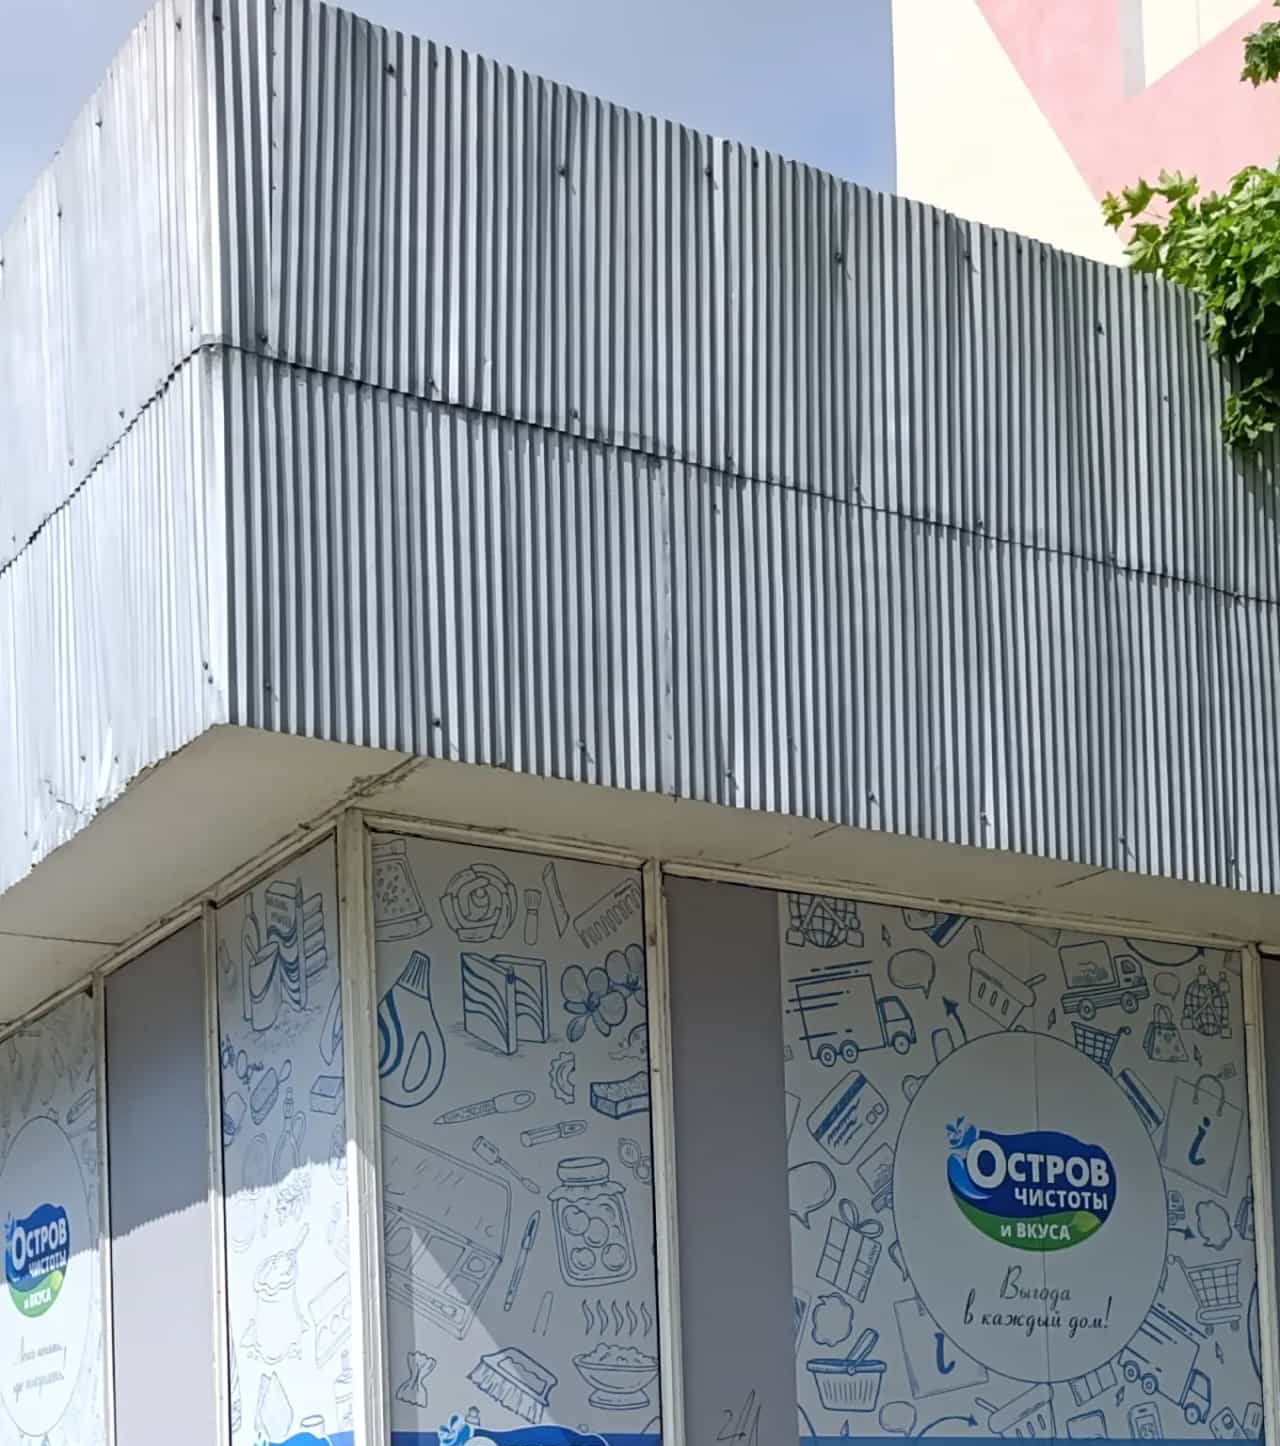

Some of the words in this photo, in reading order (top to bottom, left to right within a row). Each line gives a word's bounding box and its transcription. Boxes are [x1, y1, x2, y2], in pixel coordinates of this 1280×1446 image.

[966, 1138, 1110, 1189] ОСТРОВ
[1014, 1188, 1108, 1210] ЧИСТОТЫ
[12, 1217, 68, 1271] ОСТРОВ
[1017, 1223, 1071, 1240] ВКУСА
[999, 1265, 1071, 1310] Выгода
[981, 1311, 1061, 1337] каждый
[1069, 1296, 1112, 1338] дом!
